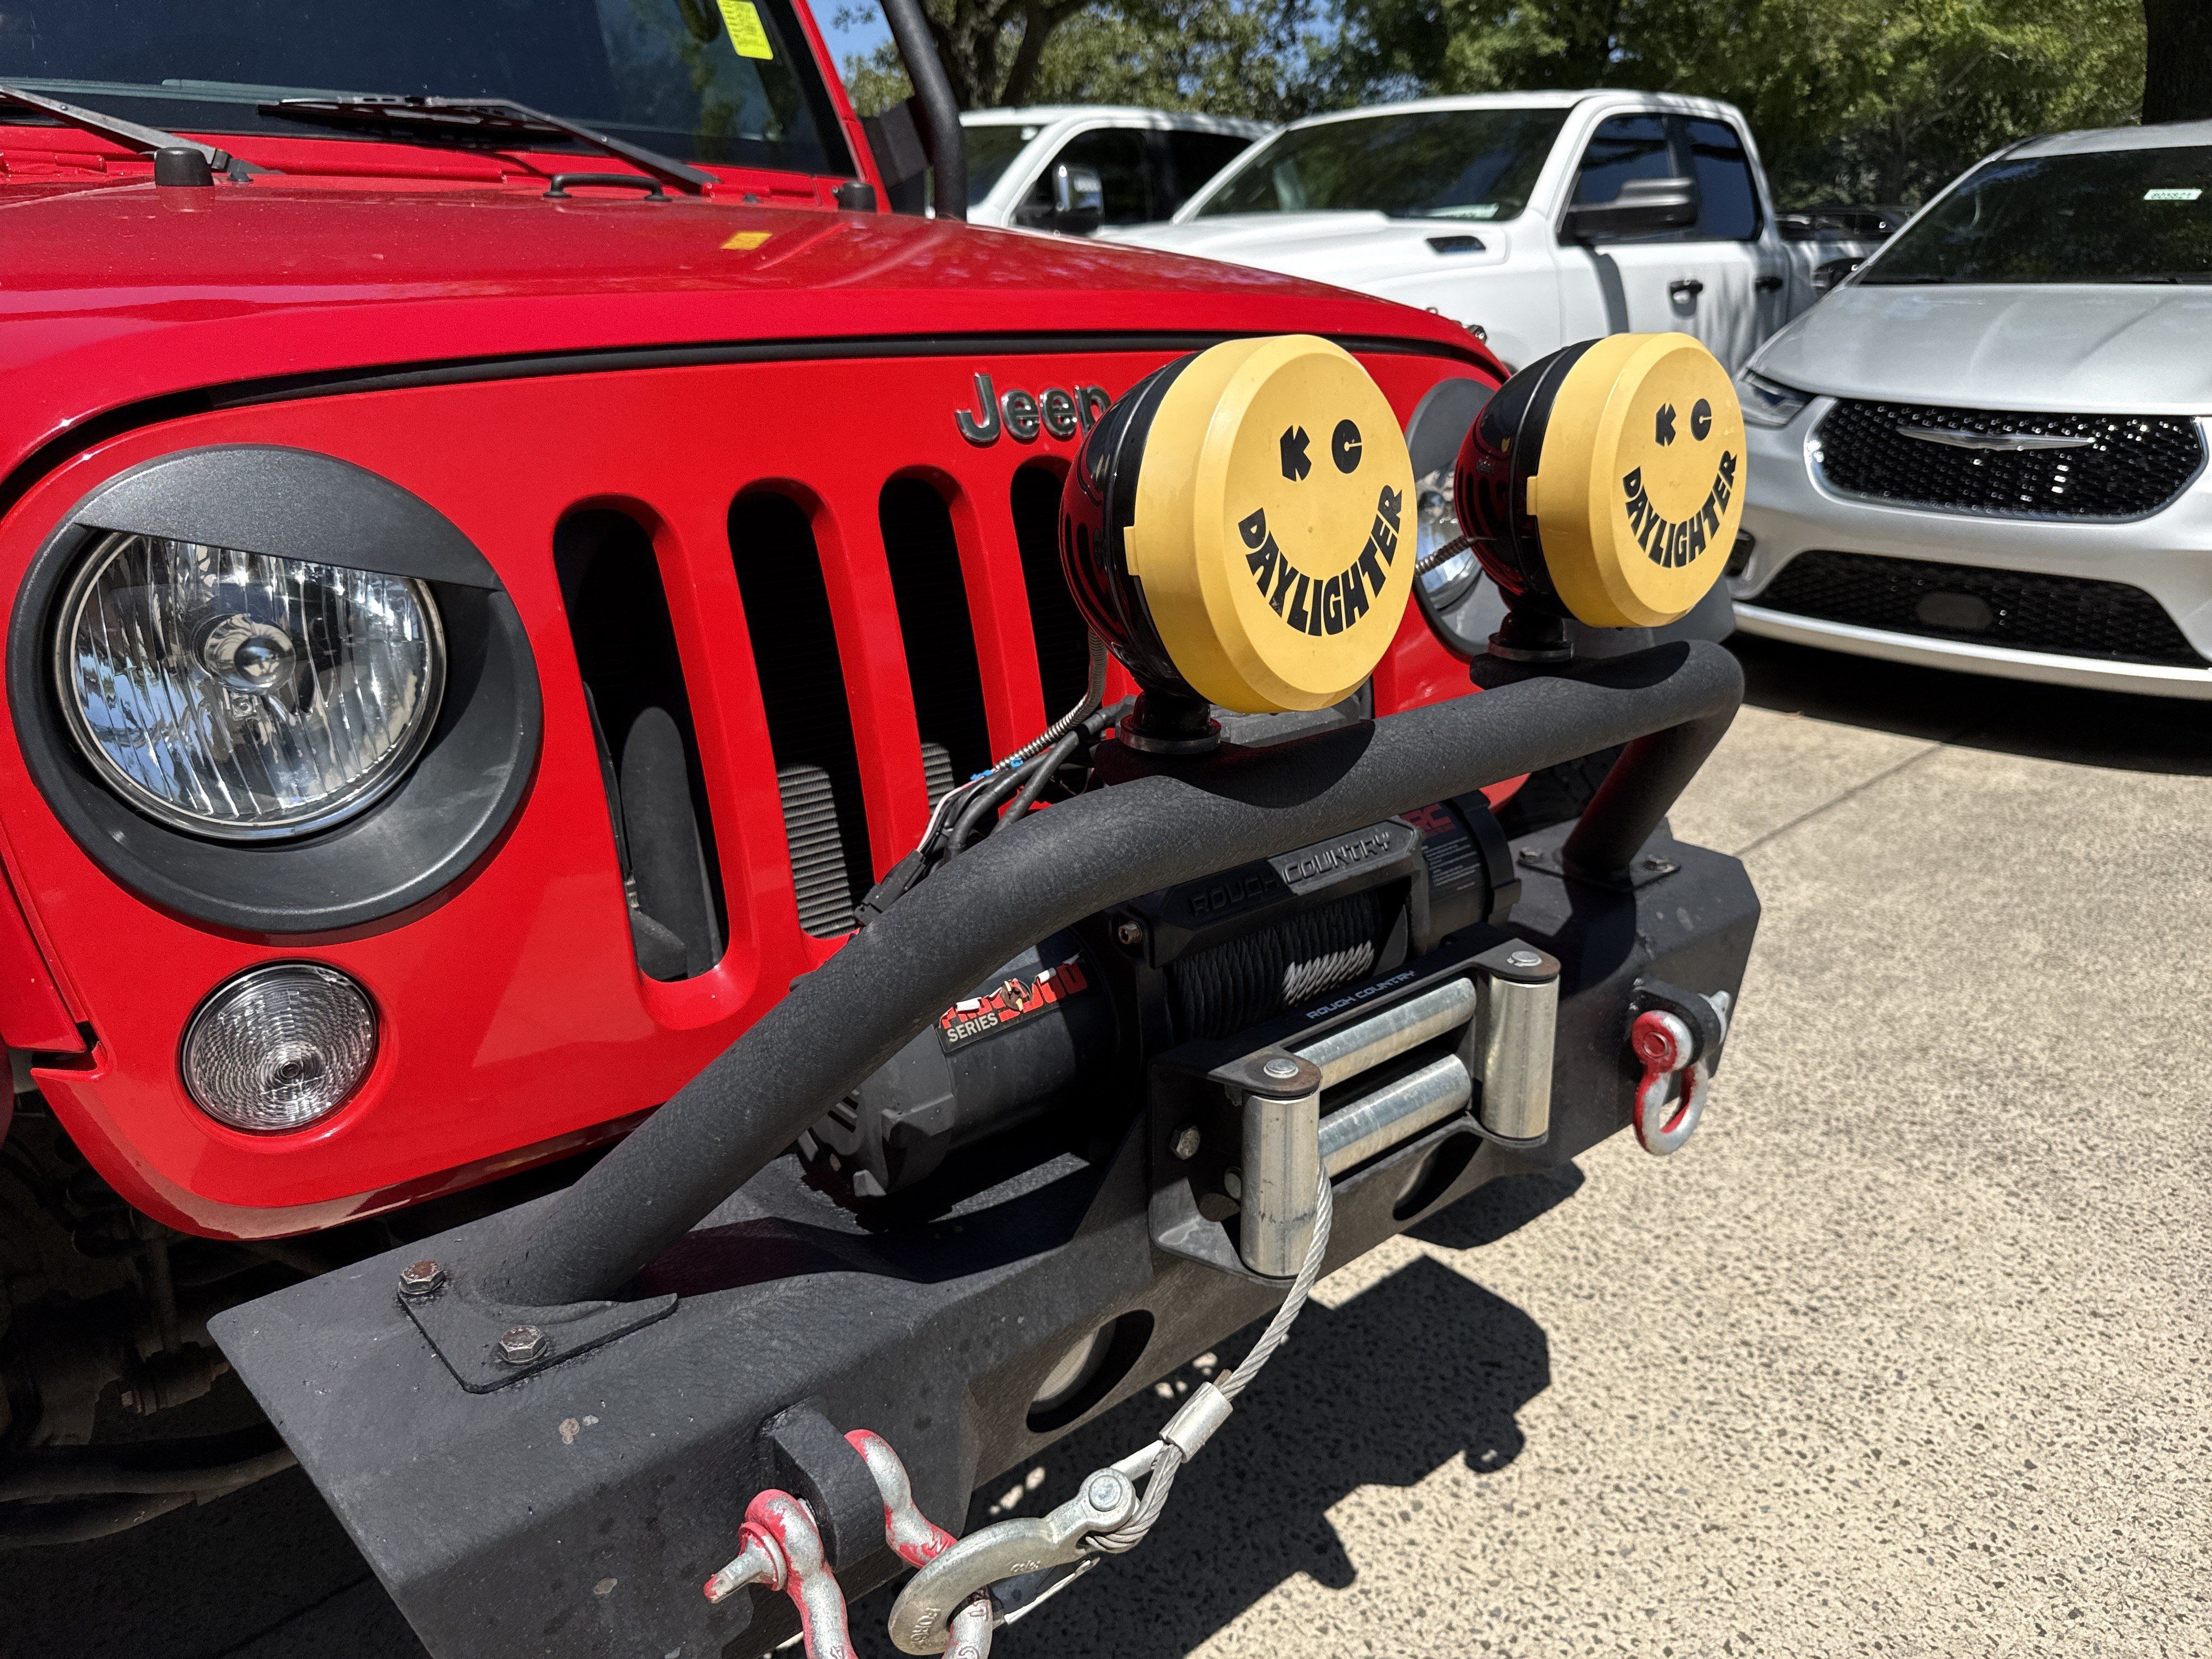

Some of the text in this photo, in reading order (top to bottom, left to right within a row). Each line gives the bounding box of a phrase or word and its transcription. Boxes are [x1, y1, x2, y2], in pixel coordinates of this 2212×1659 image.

[1622, 450, 1737, 569] DAYLIGHTER
[1238, 484, 1402, 637] DAYLIGHTER
[1282, 831, 1390, 885] COUNTRY
[1306, 970, 1416, 1019] ROUGH COUNTRY
[947, 1012, 998, 1042] SERIES
